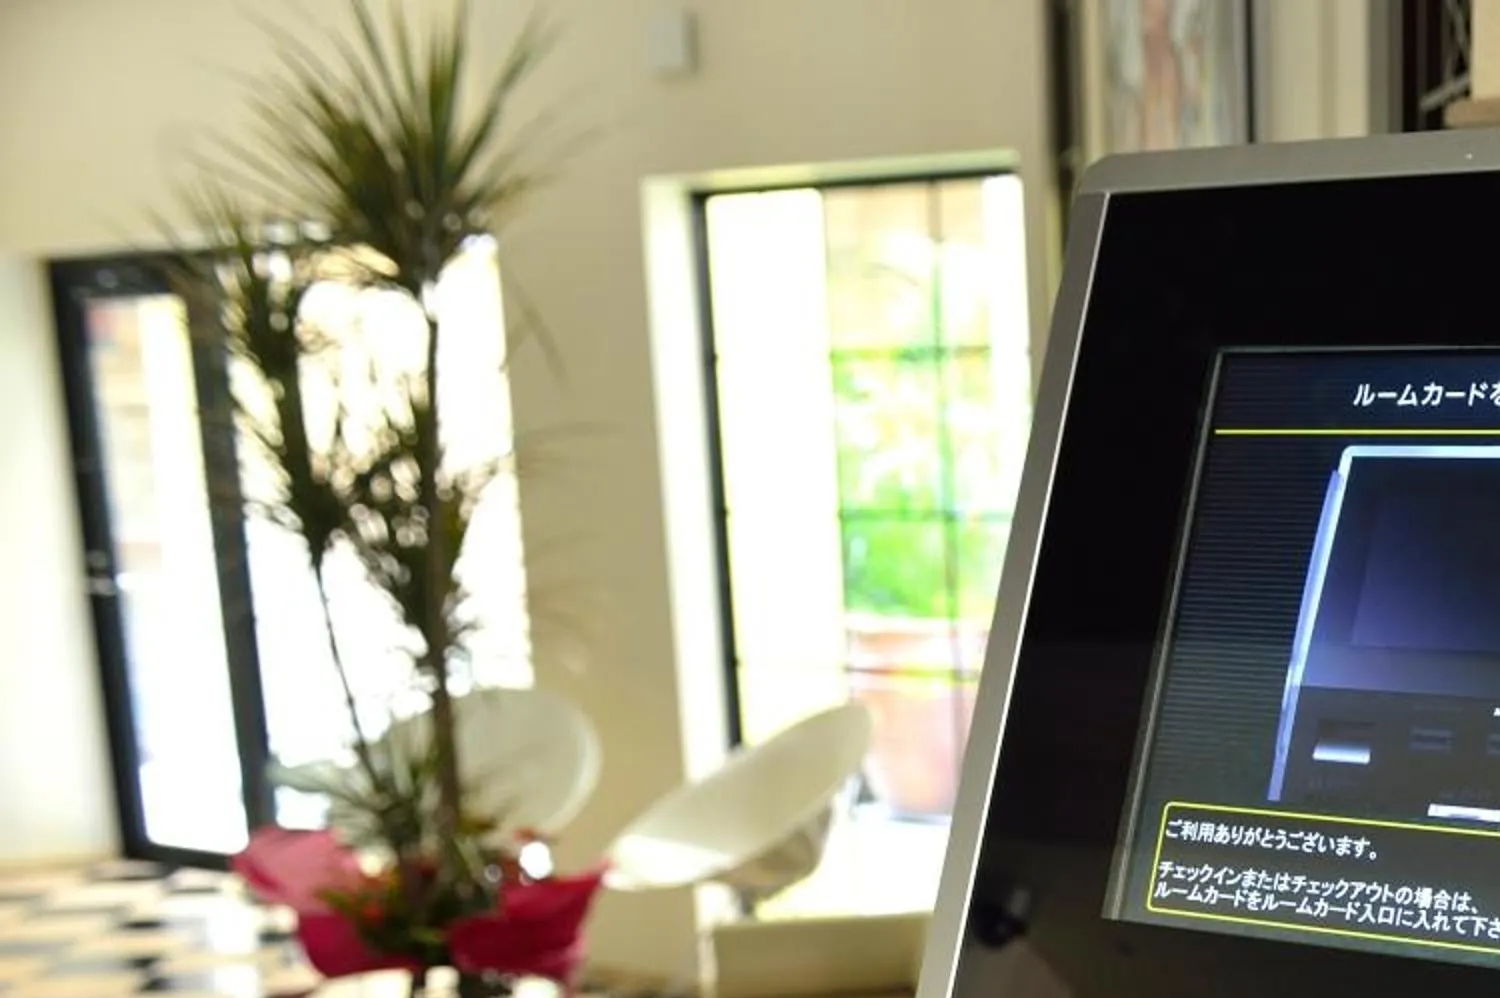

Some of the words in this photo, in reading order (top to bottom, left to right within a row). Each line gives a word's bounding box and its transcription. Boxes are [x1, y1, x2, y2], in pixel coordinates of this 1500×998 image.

[1166, 819, 1378, 860] ご利用ありがとうございます。
[1158, 861, 1479, 914] チェックインまたはチェックアウトの場合は、
